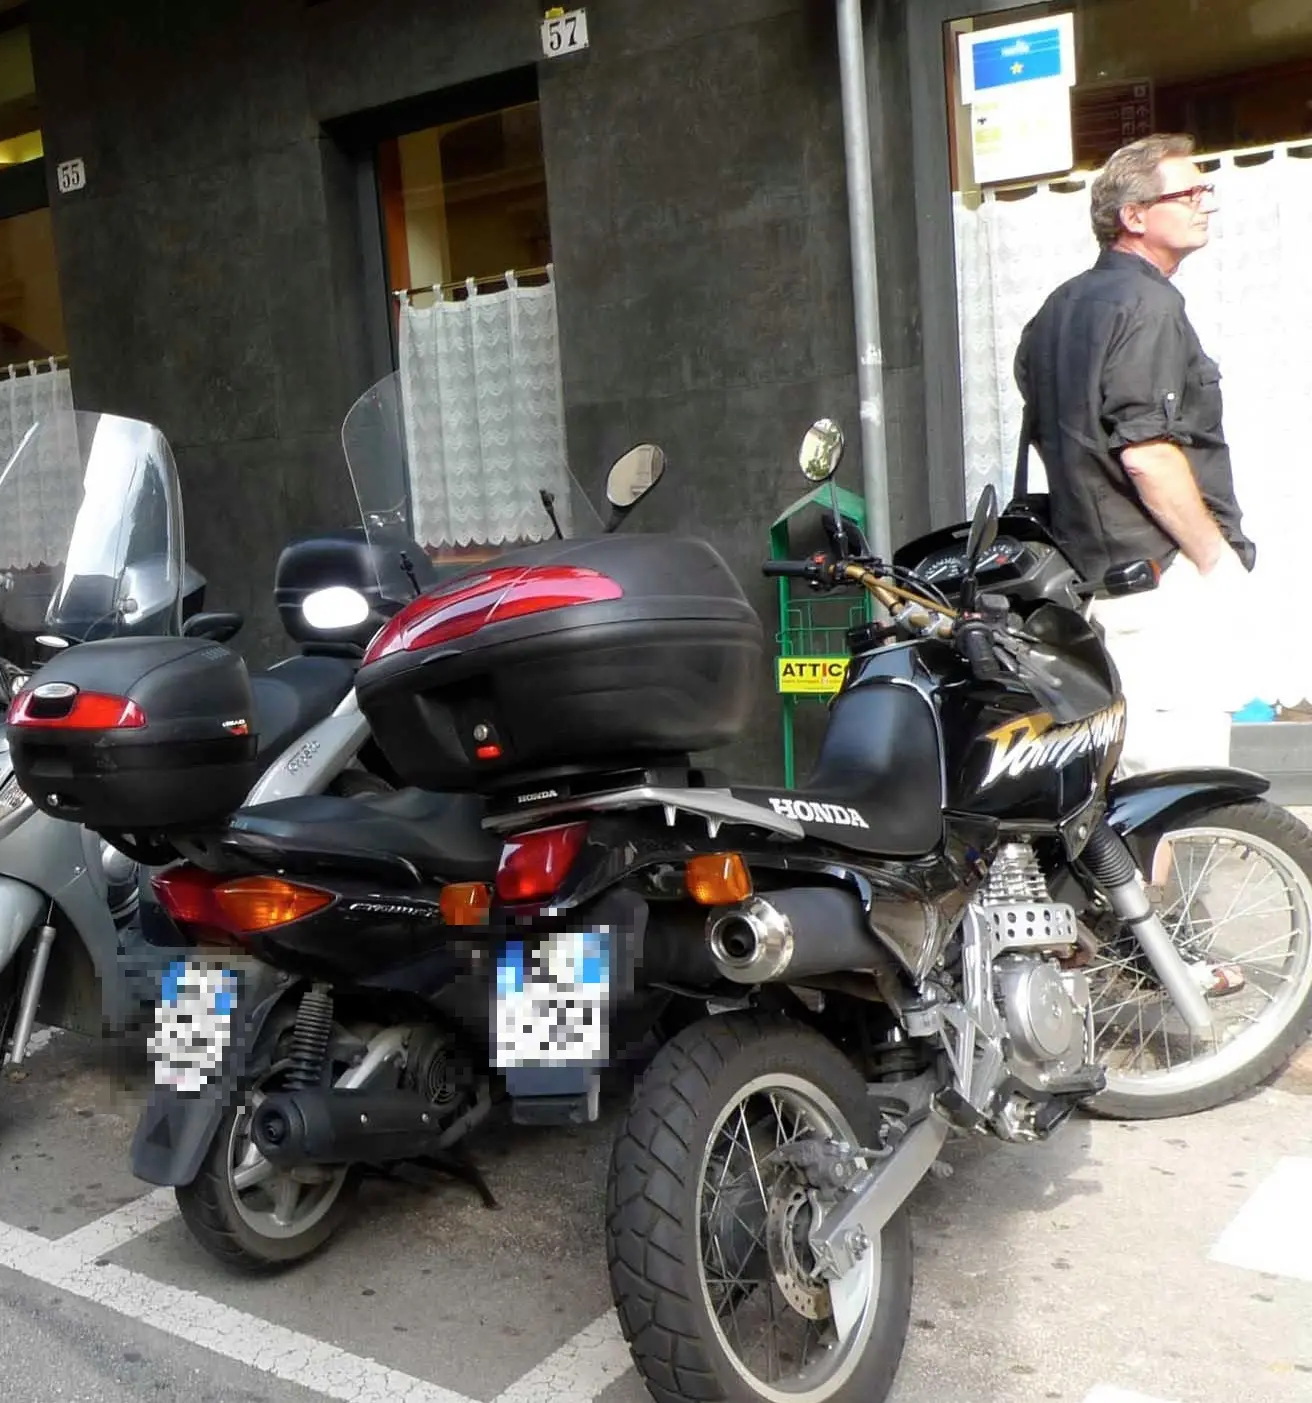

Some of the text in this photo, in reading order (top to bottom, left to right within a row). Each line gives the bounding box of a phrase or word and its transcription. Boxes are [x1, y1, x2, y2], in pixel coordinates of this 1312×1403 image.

[549, 17, 577, 50] 57
[62, 163, 79, 188] 55
[783, 663, 850, 677] ATTIC
[518, 790, 558, 803] HONDA
[768, 797, 870, 829] HONDA
